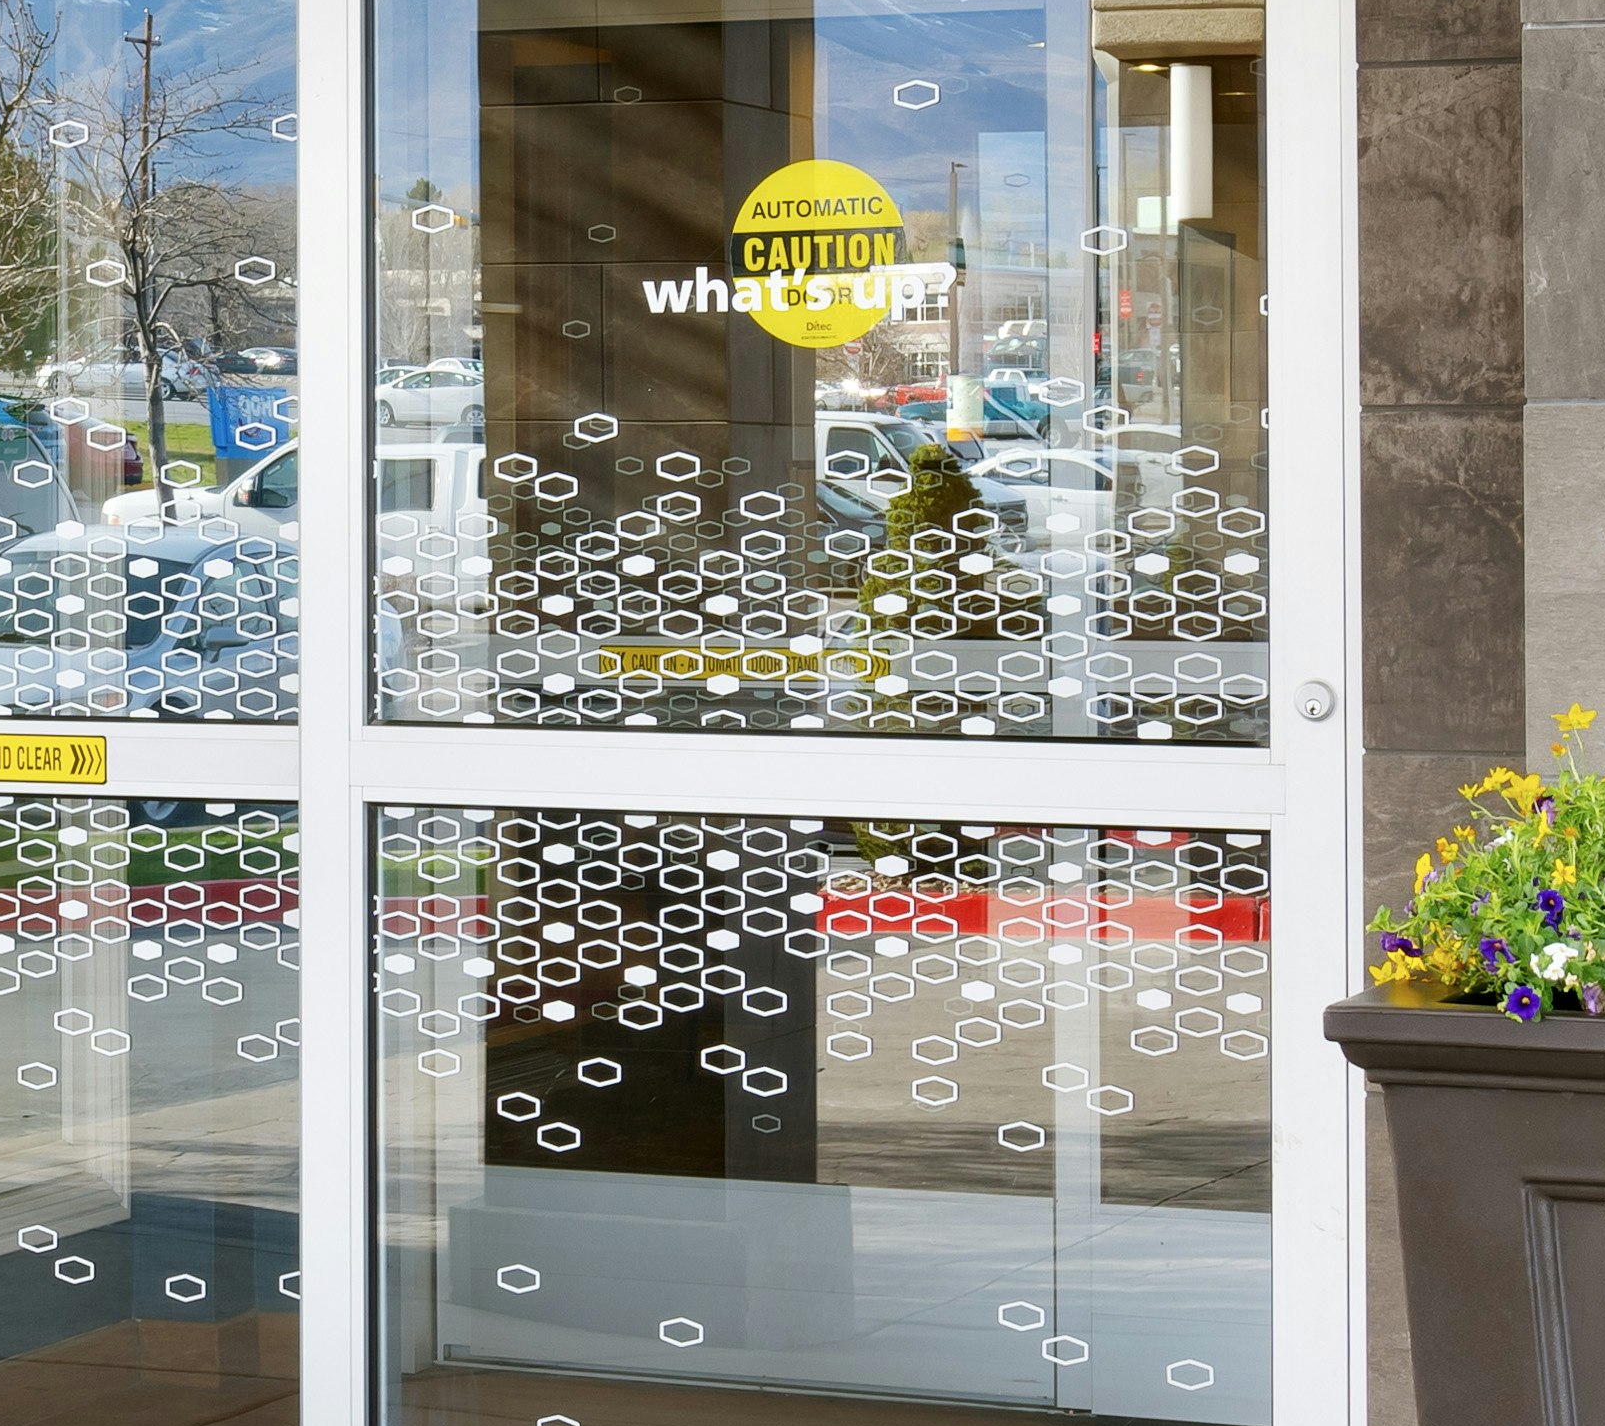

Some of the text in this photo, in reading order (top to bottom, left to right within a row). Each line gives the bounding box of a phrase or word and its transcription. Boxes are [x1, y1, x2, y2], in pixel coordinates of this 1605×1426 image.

[751, 196, 883, 220] AUTOMATIC
[743, 232, 895, 272] CAUTION
[853, 261, 958, 323] up?
[631, 654, 677, 672] CAUTON
[687, 655, 744, 673] AUTOMATI
[17, 746, 62, 771] CLEAR
